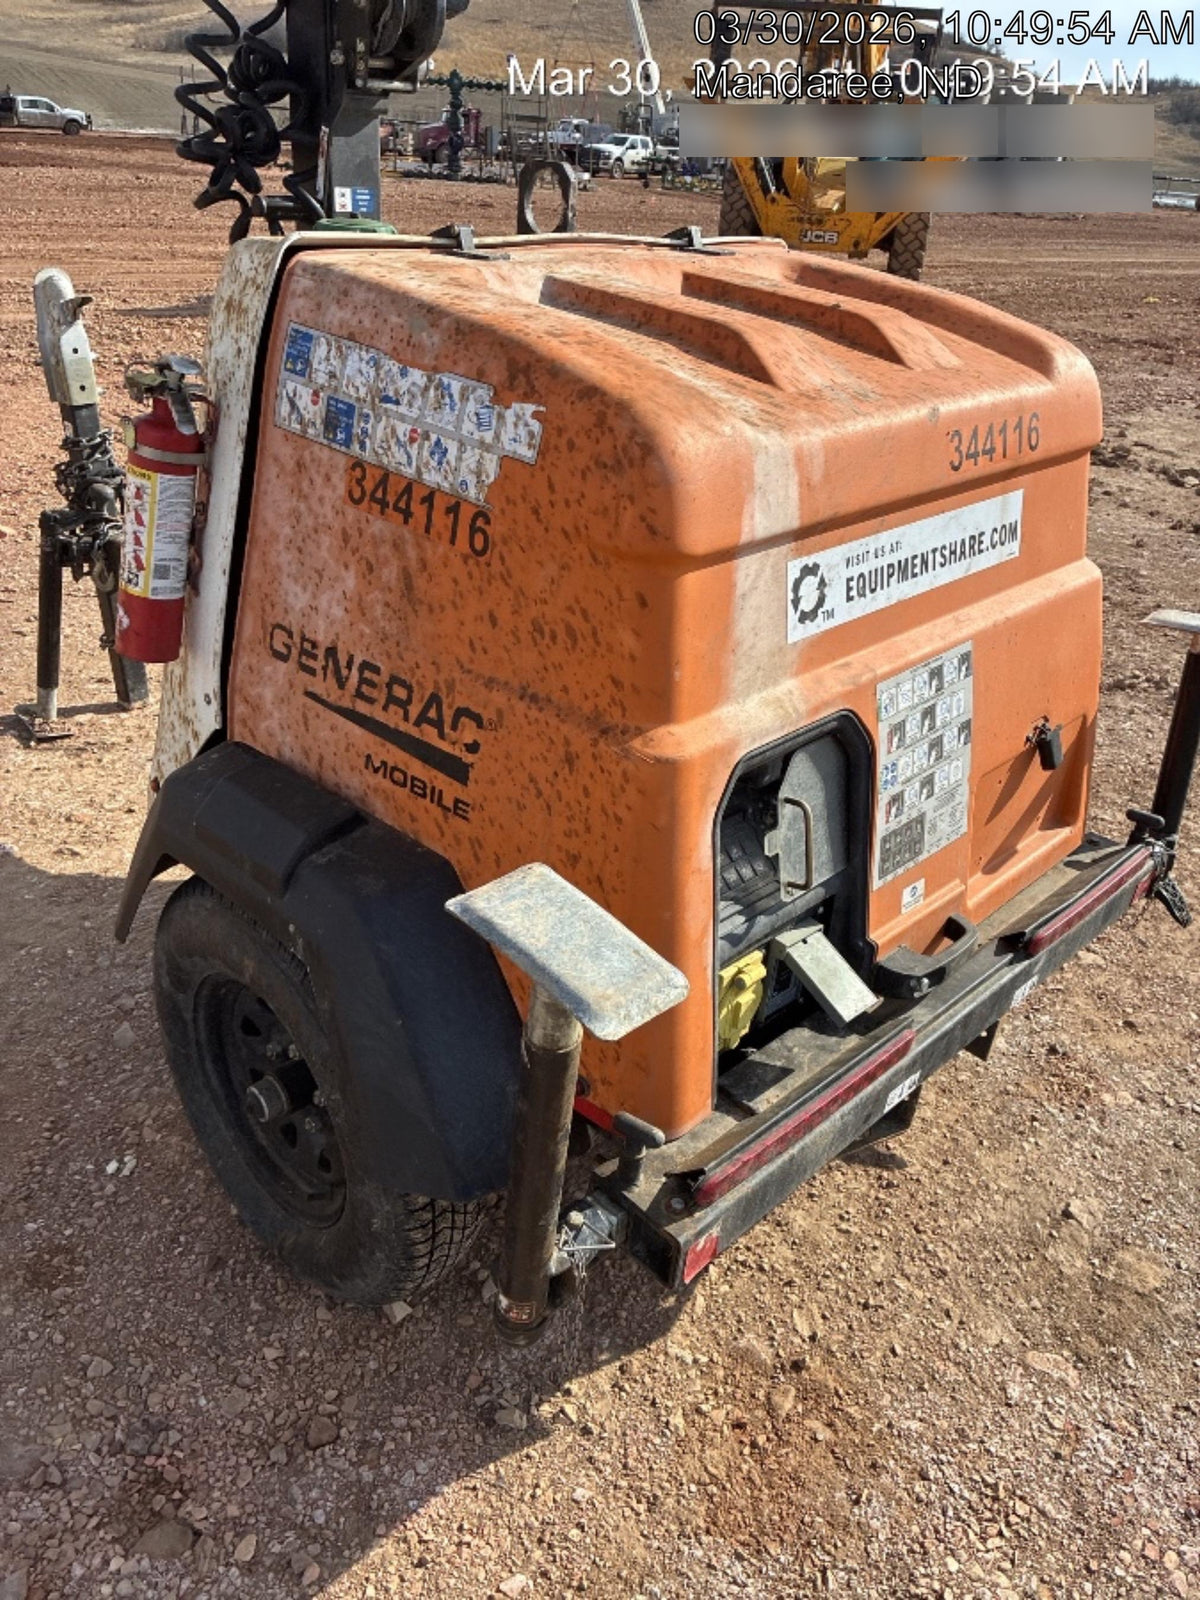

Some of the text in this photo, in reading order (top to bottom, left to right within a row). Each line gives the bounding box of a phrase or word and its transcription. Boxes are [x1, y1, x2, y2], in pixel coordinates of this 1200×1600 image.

[800, 229, 839, 245] JCB
[949, 411, 1040, 472] 344116
[347, 461, 492, 558] 344116
[845, 550, 870, 569] VISIT
[873, 544, 886, 559] US
[845, 519, 1018, 604] EQUIPMENTSHARE.COM
[268, 622, 485, 755] GENERAC
[364, 753, 473, 822] MOBILE
